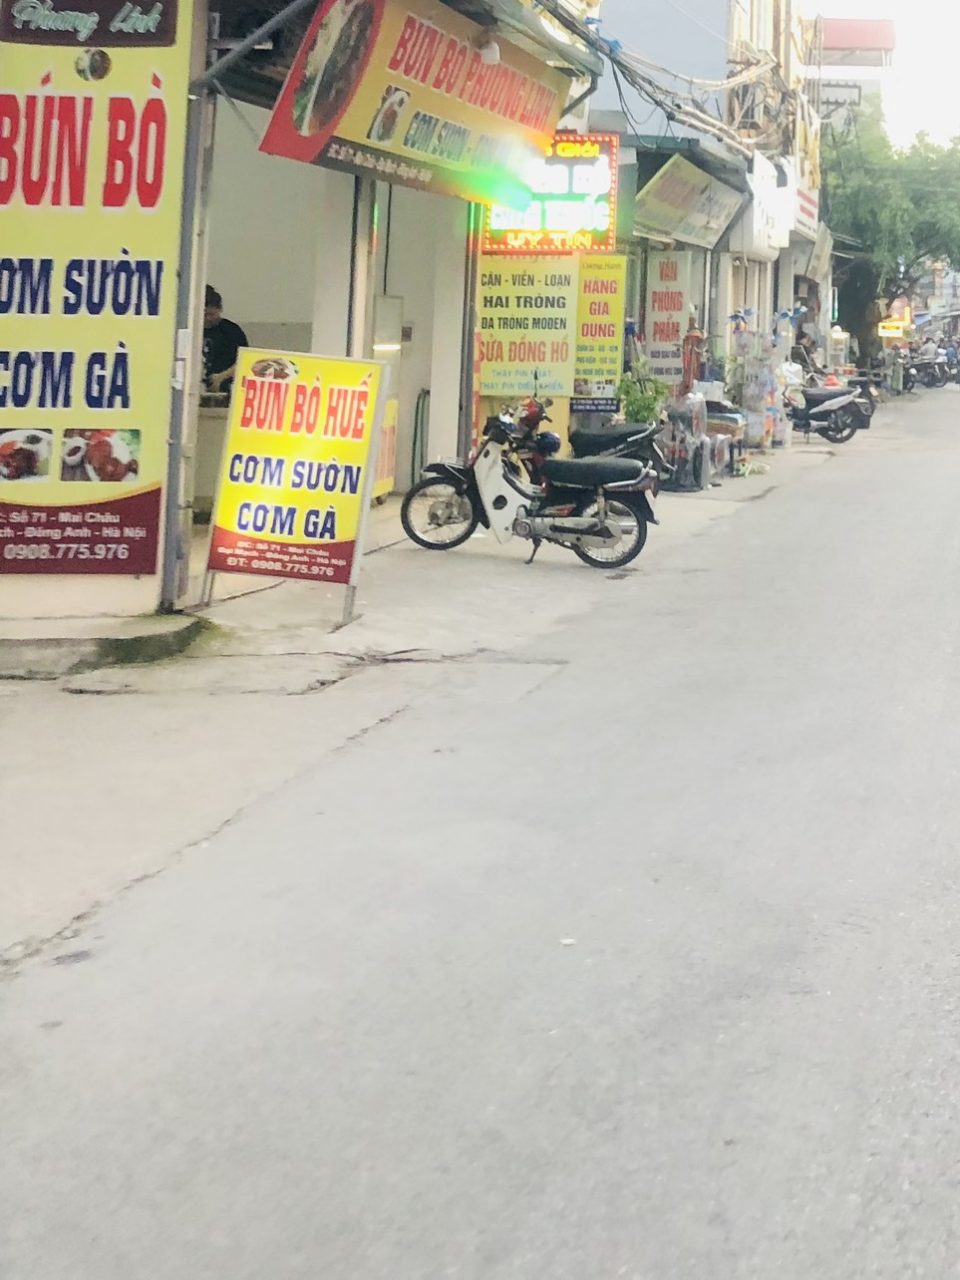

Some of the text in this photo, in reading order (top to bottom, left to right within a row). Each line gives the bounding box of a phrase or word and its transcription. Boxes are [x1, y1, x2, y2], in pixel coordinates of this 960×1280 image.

[0, 71, 167, 208] BÚN BÒ
[506, 231, 543, 248] UY
[0, 247, 163, 315] ƠM SƯỜN
[583, 276, 618, 294] HÀNG
[483, 295, 509, 308] HAI
[589, 301, 610, 316] GIA
[581, 324, 615, 341] DỤNG
[86, 340, 130, 408] GÀ
[291, 375, 321, 434] BÒ
[323, 373, 372, 439] HUẾ
[229, 454, 361, 494] CƠM SƯỜN
[31, 512, 47, 523] 71
[58, 511, 82, 523] Mai
[237, 502, 336, 540] CƠM GÀ
[64, 527, 91, 538] Anh
[101, 526, 121, 538] Hà
[123, 527, 147, 540] Nội
